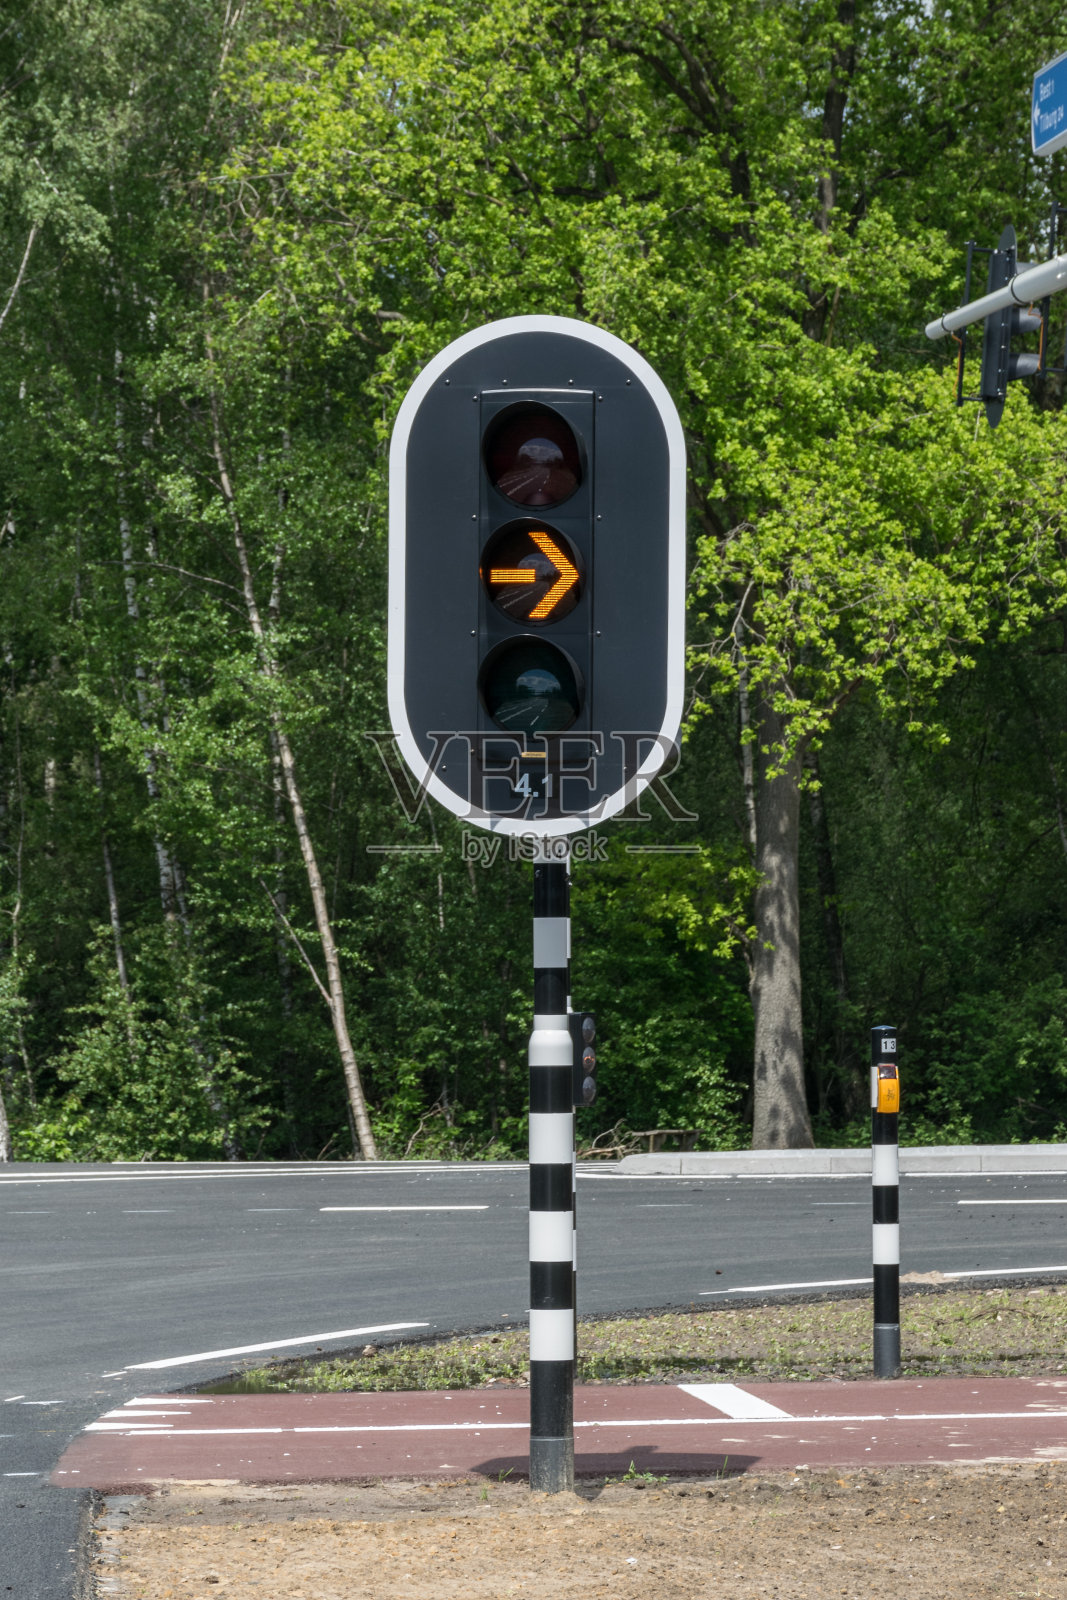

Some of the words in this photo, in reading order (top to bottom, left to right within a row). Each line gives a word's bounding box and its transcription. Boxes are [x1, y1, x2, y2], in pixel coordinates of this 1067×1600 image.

[1040, 80, 1051, 102] Best
[514, 773, 552, 797] 4.1
[883, 1040, 896, 1050] 13
